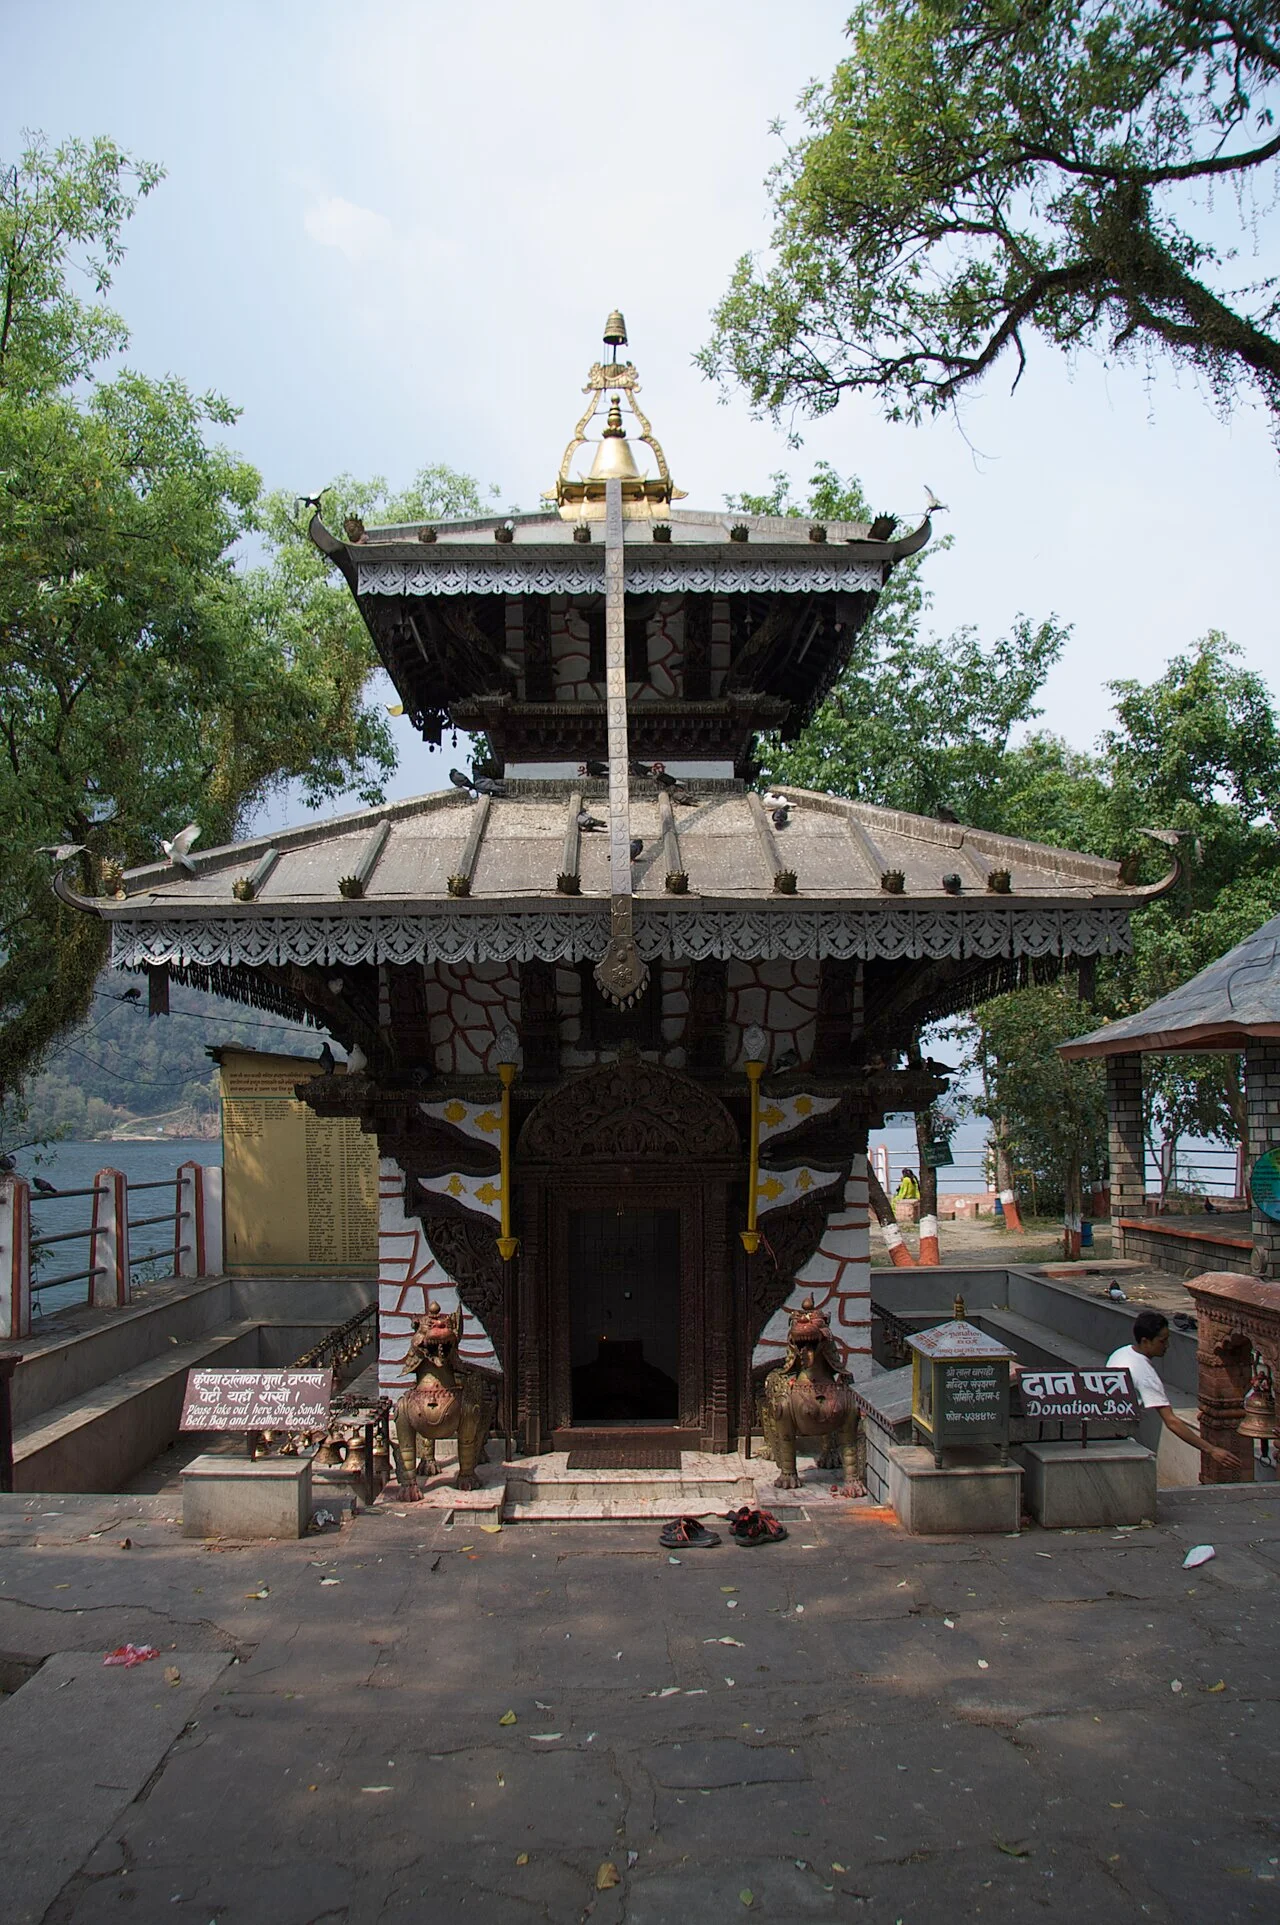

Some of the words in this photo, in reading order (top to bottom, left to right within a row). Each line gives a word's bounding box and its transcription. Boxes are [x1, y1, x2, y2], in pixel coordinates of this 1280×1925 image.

[1021, 1372, 1077, 1399] दान
[1079, 1372, 1130, 1396] पत्र
[200, 1386, 222, 1403] पेटी
[227, 1388, 254, 1405] यहाँ
[187, 1404, 211, 1416] Please
[213, 1403, 232, 1415] take
[232, 1403, 250, 1415] out
[252, 1403, 273, 1415] here
[1026, 1400, 1103, 1416] Donation
[1103, 1399, 1136, 1415] Box
[208, 1415, 227, 1428] Bag
[229, 1415, 250, 1426] and
[248, 1414, 283, 1426] Leather
